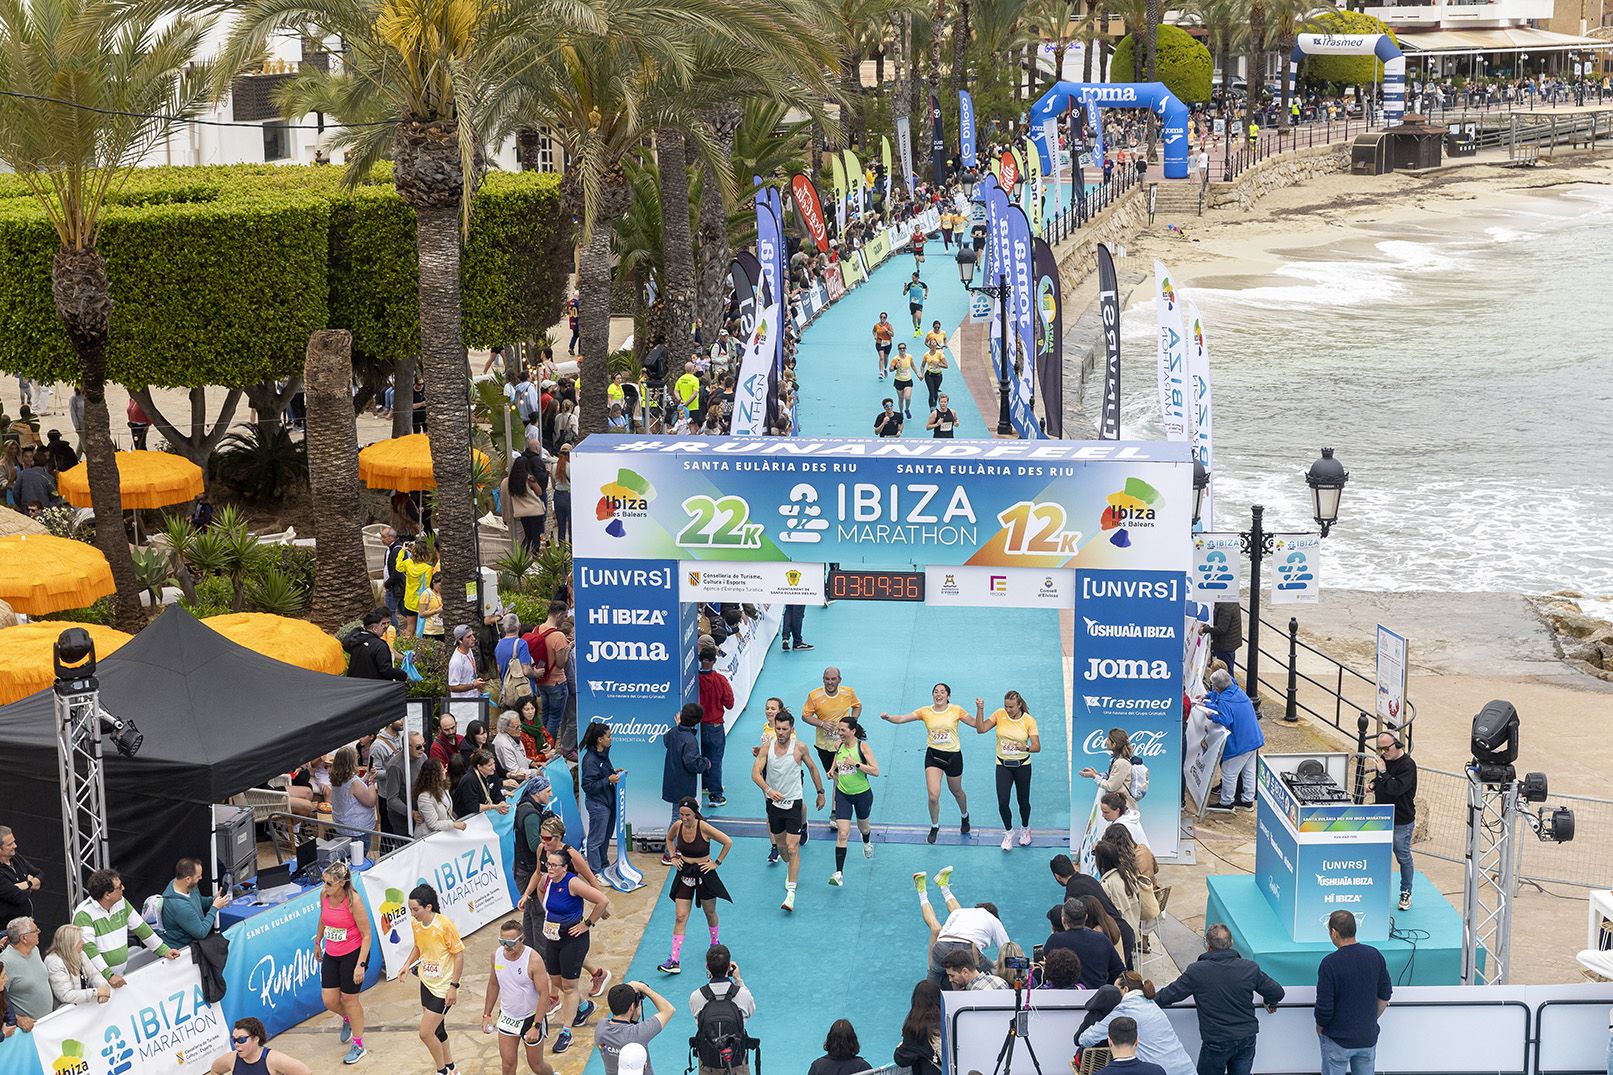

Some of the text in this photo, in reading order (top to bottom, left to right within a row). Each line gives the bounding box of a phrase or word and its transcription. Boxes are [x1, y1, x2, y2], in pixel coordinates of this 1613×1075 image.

[1321, 37, 1363, 47] Trasmed
[613, 441, 1150, 459] #RUNANDFEEL
[684, 461, 858, 473] SANTA EULÀRIA DES RIU
[896, 463, 1074, 477] SANTA EULÀRIA DES RIU
[606, 495, 648, 511] Ibiza
[838, 483, 977, 525] IBIZA
[622, 511, 648, 519] Balears
[1111, 504, 1156, 521] Ibiza
[1128, 520, 1155, 528] Balears
[838, 525, 977, 547] MARATHON
[1216, 539, 1239, 547] IBIZA
[1297, 538, 1319, 547] IBIZA
[581, 567, 671, 589] [UNVRS]
[727, 580, 746, 588] Esports
[1084, 578, 1177, 602] [UNVRS]
[1143, 625, 1176, 639] IBIZA
[605, 680, 671, 694] Trasmed
[1101, 696, 1173, 711] Trasmed
[434, 844, 495, 894] IBIZA
[1322, 860, 1367, 871] [UNVRS]
[1353, 877, 1373, 886] IBIZA
[441, 868, 498, 912] MARATHON
[246, 923, 270, 940] SANTA
[303, 905, 316, 917] DES
[383, 905, 407, 925] Ibiza
[130, 984, 212, 1044] IBIZA
[501, 1015, 521, 1028] 2028
[139, 1011, 218, 1066] MARATHON
